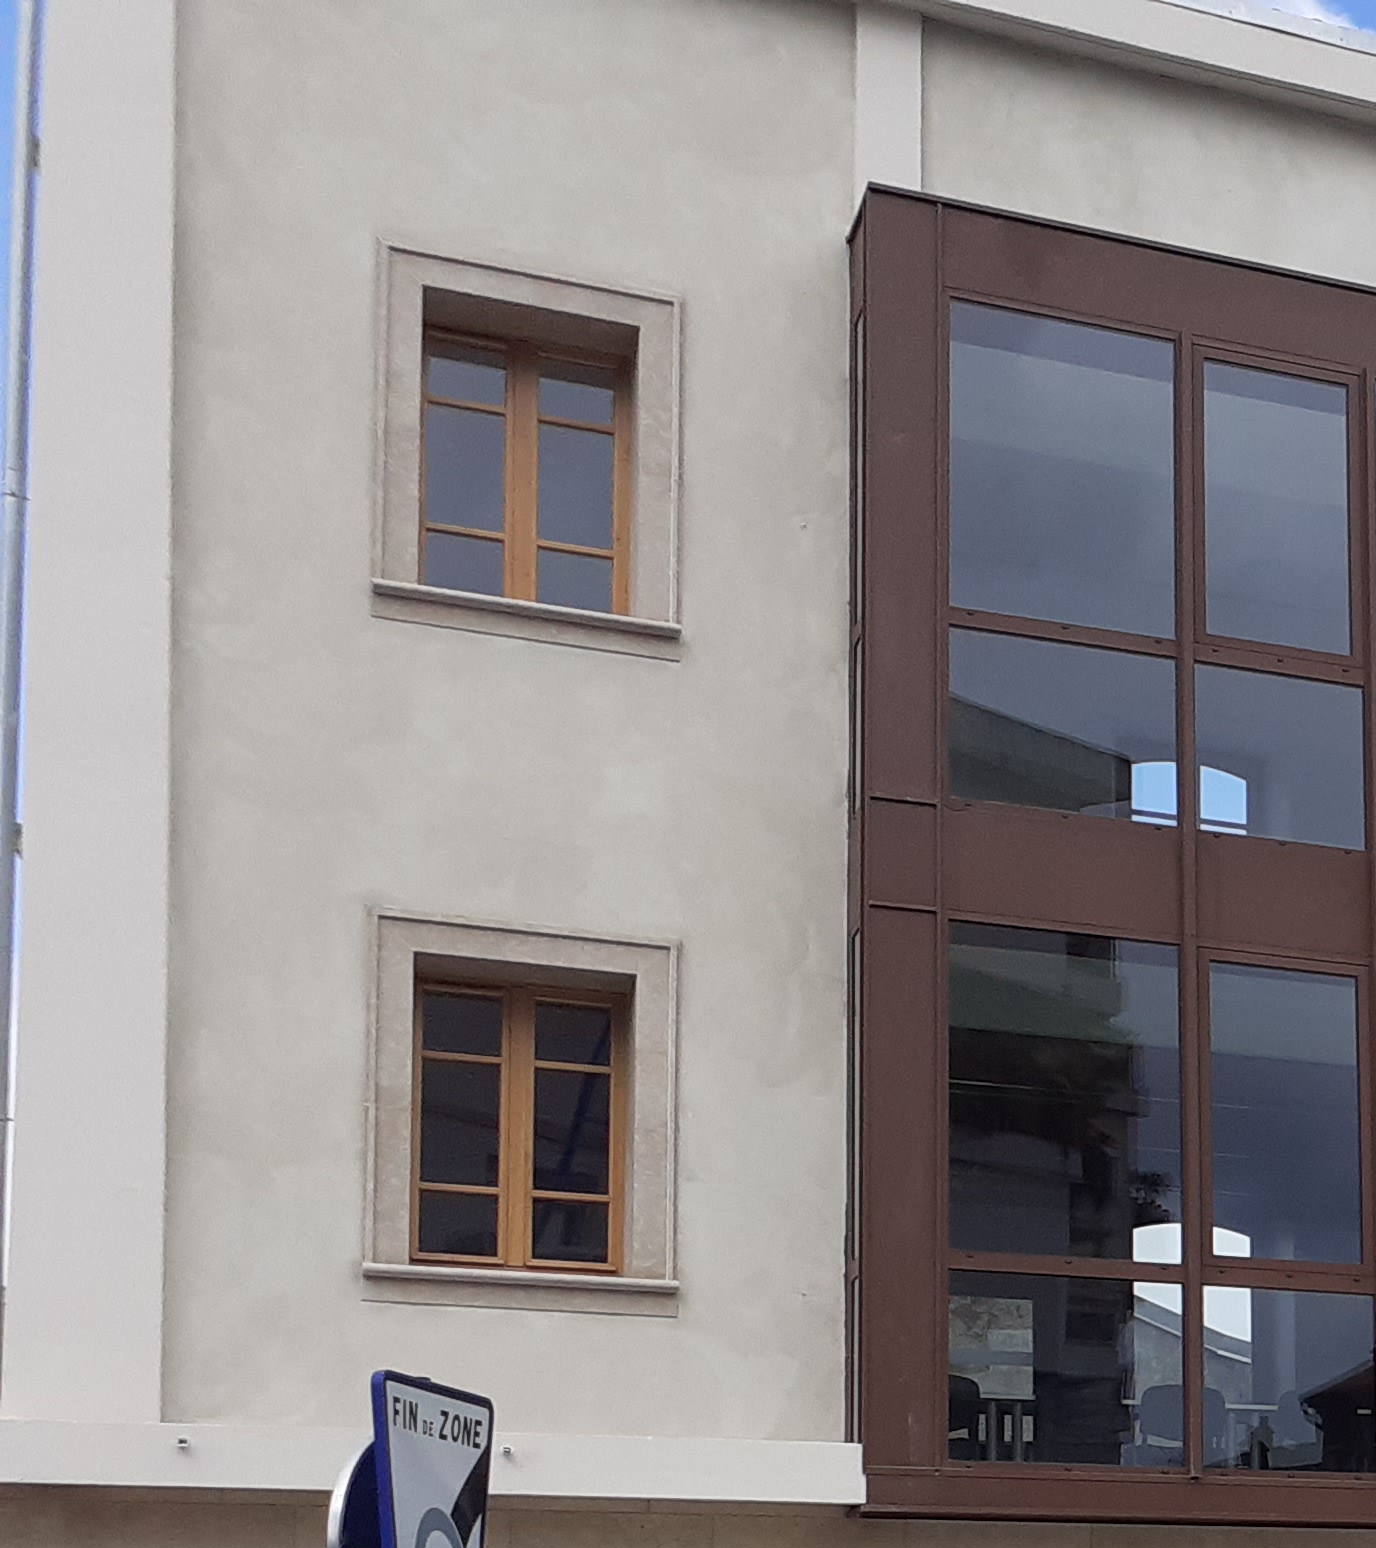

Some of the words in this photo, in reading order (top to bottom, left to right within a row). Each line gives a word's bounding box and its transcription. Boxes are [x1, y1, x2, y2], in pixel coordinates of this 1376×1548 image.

[392, 1396, 419, 1433] FIN
[422, 1419, 434, 1437] DE
[438, 1409, 483, 1449] ZONE
